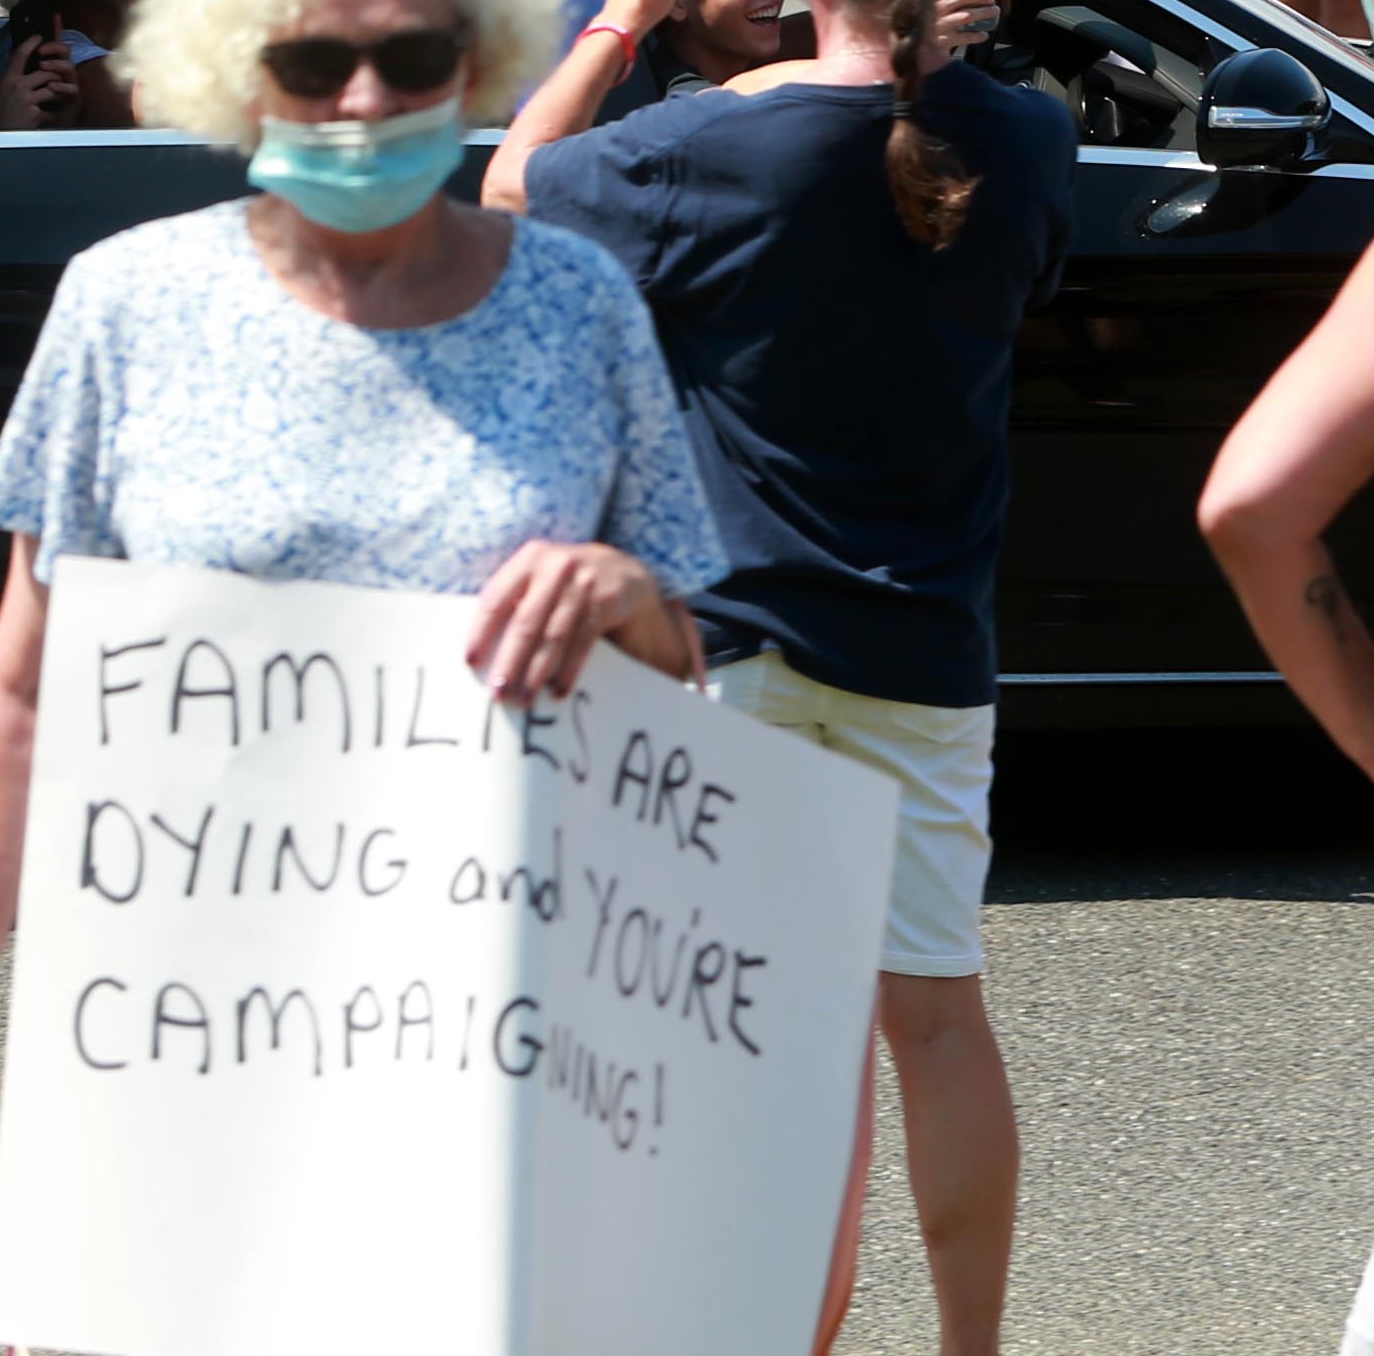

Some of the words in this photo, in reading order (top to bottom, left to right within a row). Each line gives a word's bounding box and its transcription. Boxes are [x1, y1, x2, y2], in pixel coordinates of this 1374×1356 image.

[99, 635, 591, 785] FAMILIES
[613, 728, 737, 864] ARE
[80, 798, 409, 904] DYING
[448, 825, 563, 924] and
[584, 866, 768, 1058] YOU'RE
[74, 977, 665, 1157] CAMPAIGNING!
